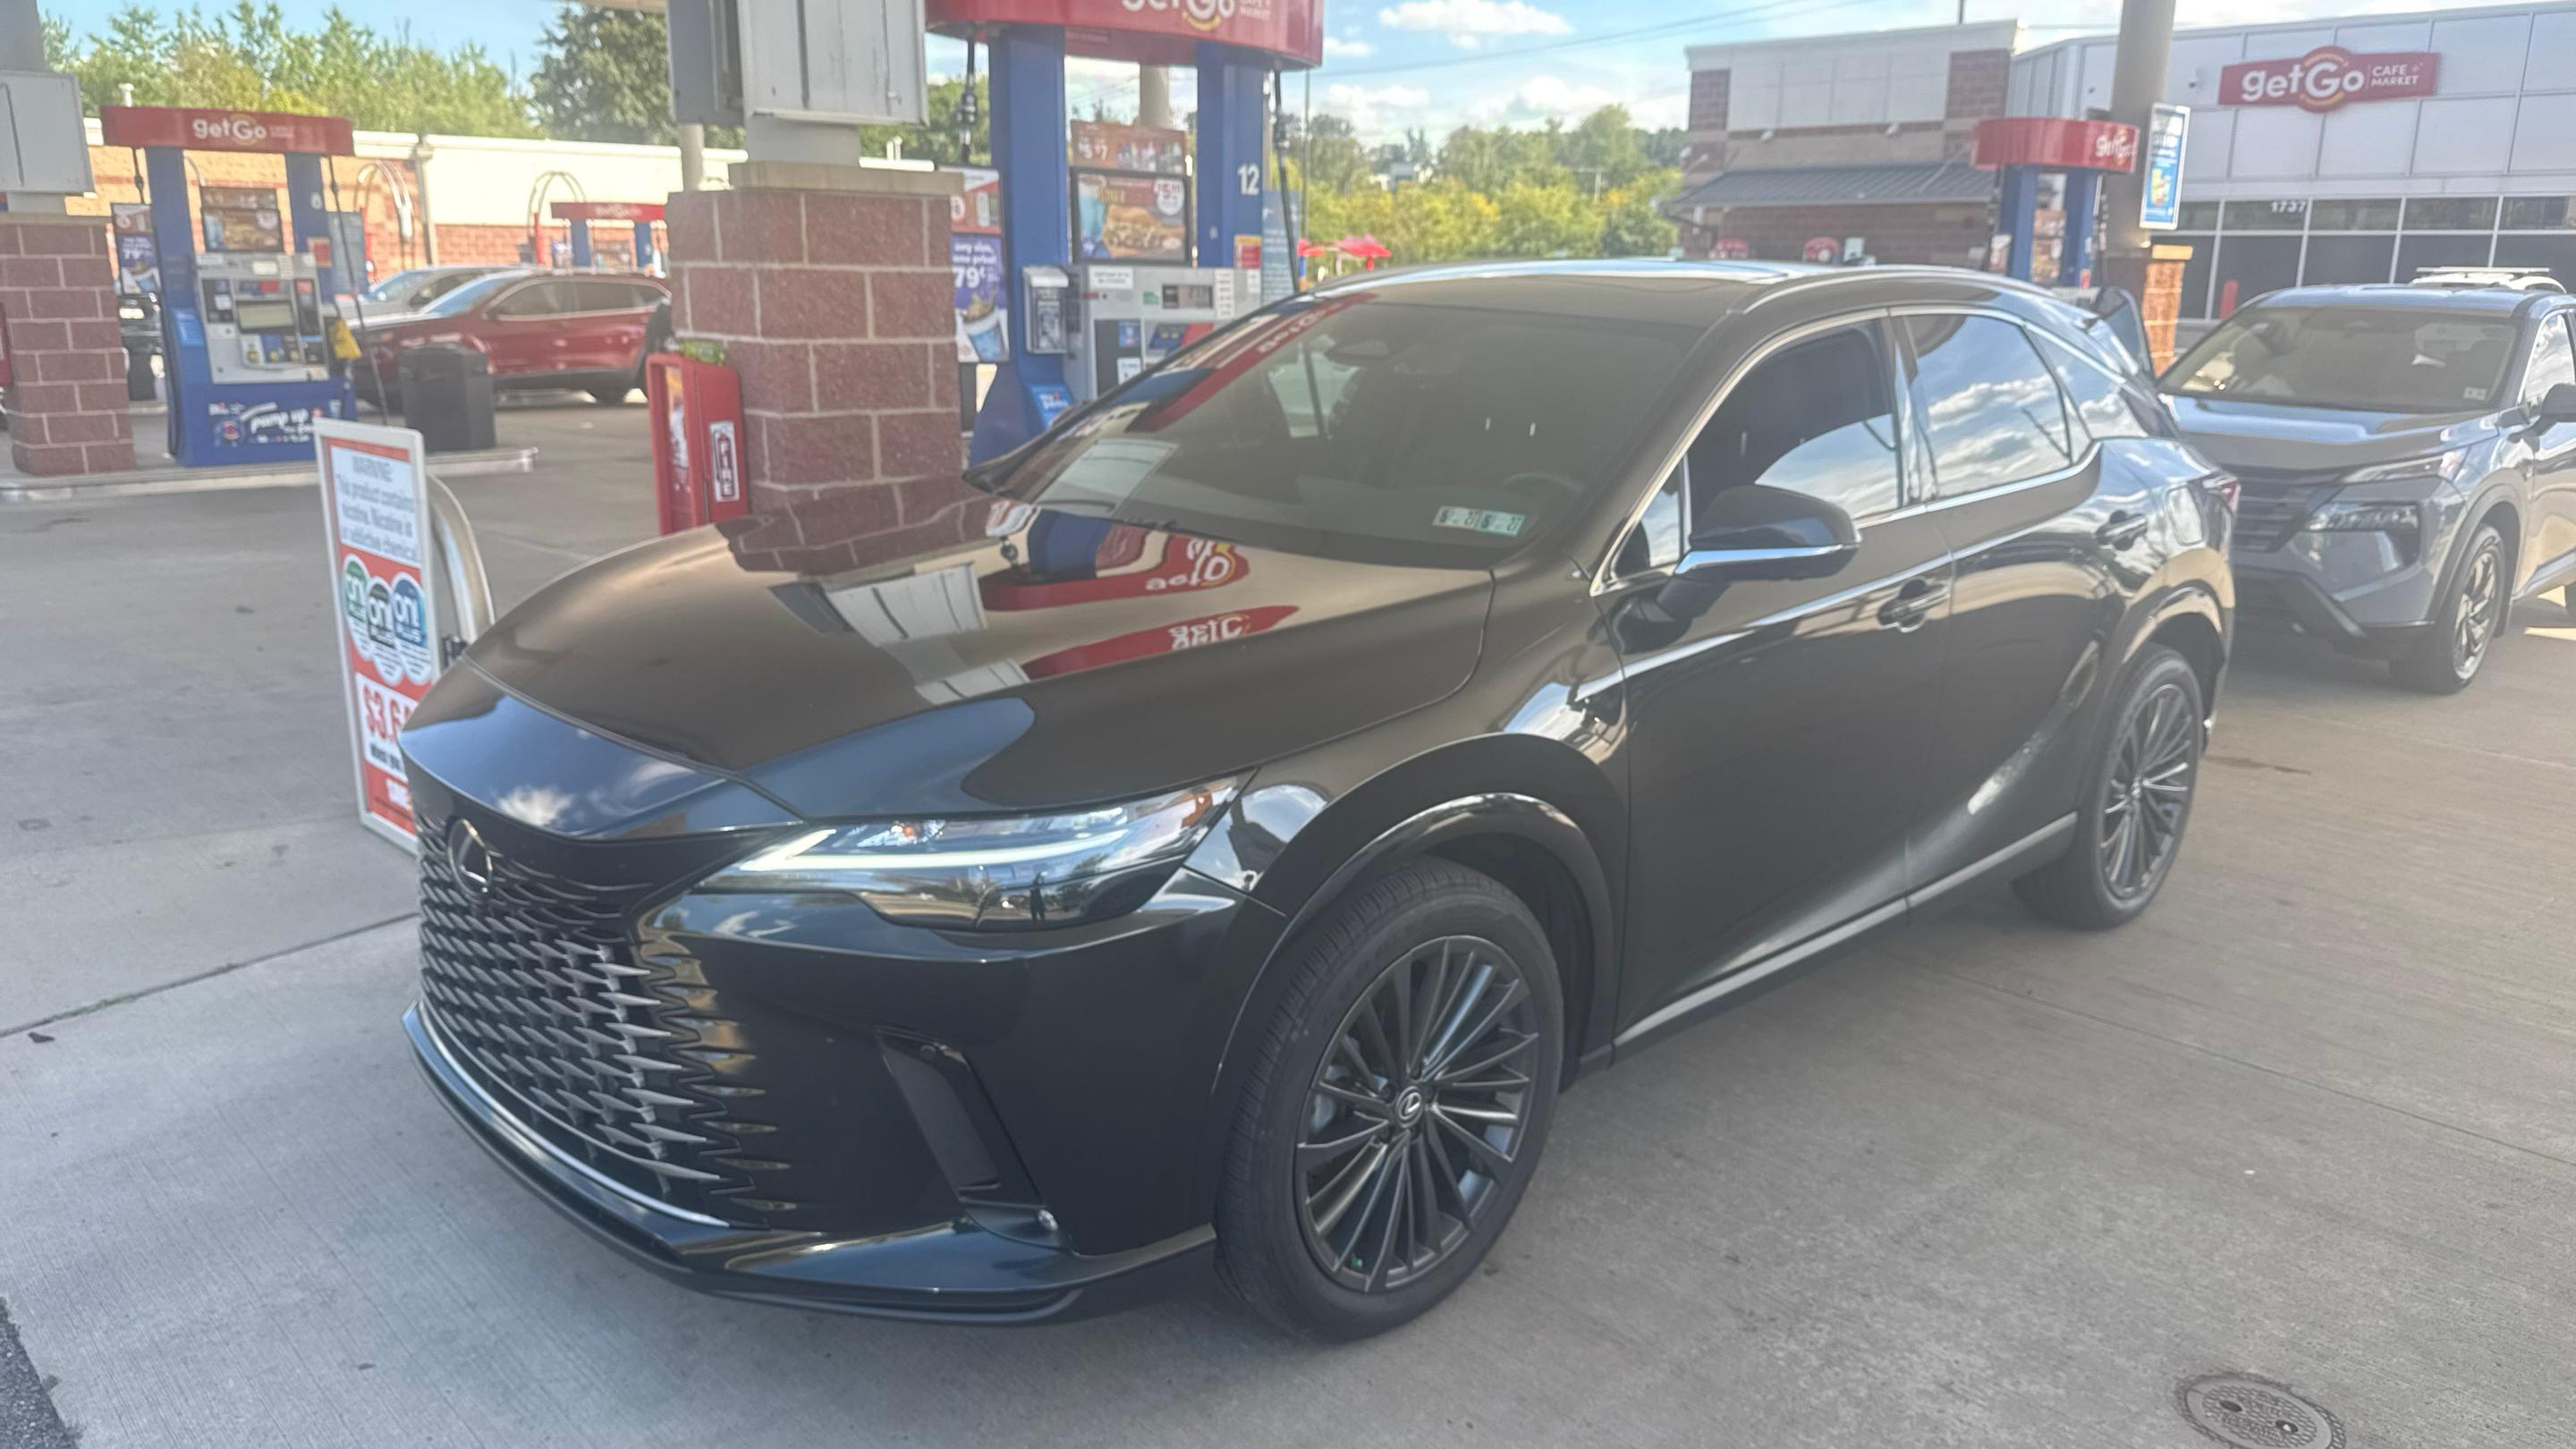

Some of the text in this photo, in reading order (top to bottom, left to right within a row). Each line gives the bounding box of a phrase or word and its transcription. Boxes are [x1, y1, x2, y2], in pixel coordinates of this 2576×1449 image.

[2241, 61, 2365, 101] getGo
[2371, 75, 2419, 87] MARKET
[2372, 64, 2407, 76] CAFE
[192, 118, 267, 140] getGo
[1238, 163, 1259, 196] 12
[2272, 201, 2306, 214] 1737
[719, 440, 733, 496] FIRE
[363, 684, 411, 744] $3.6
